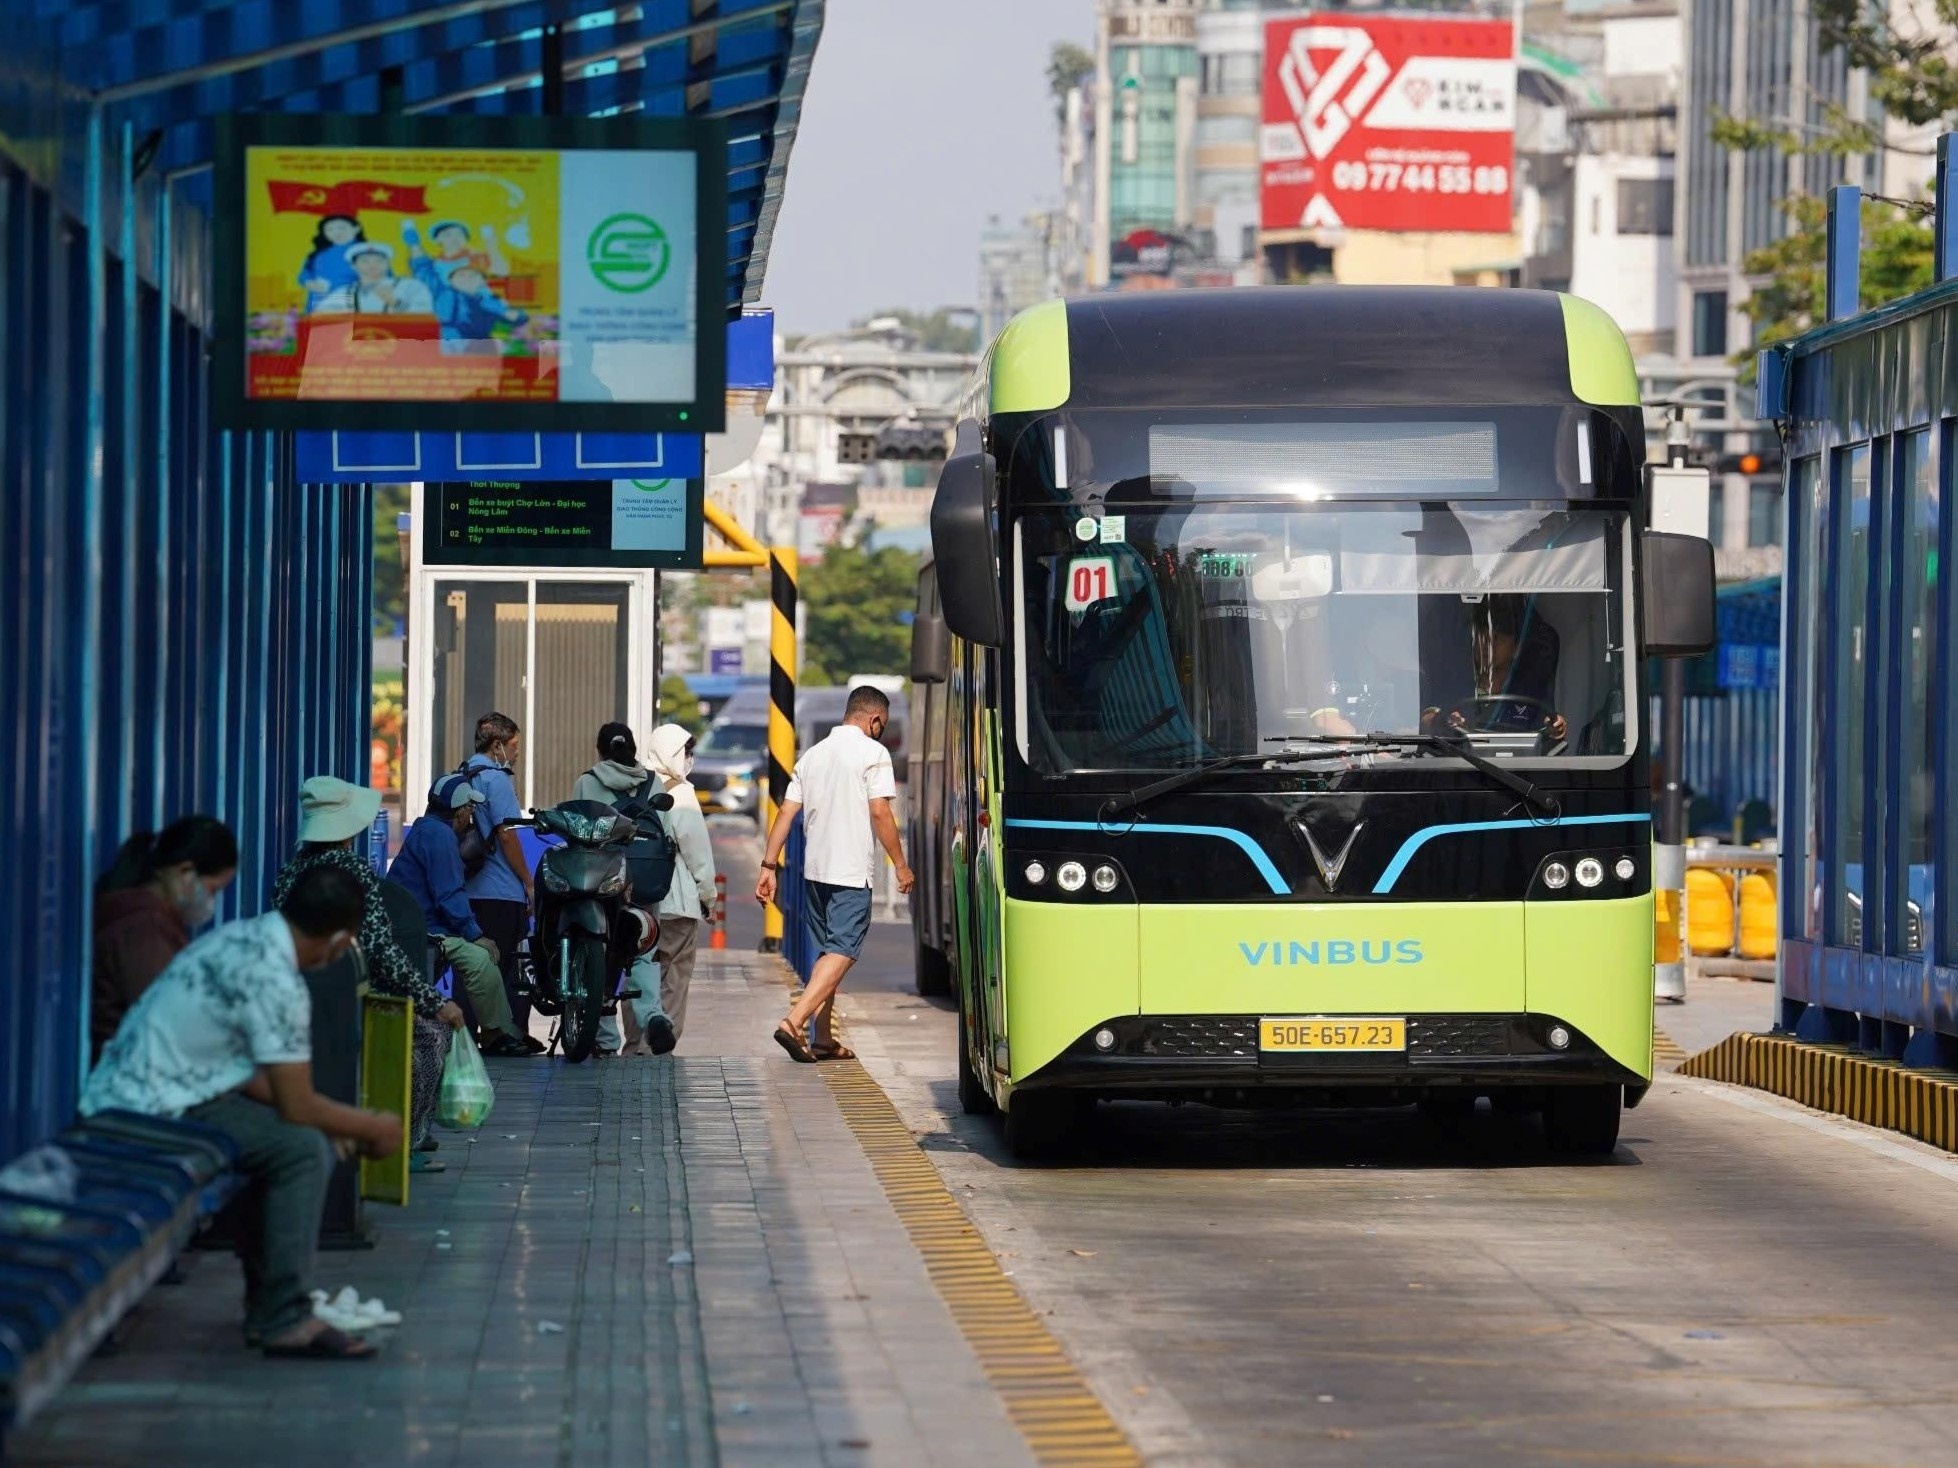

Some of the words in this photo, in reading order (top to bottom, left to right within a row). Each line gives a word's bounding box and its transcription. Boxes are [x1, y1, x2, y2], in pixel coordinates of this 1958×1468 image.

[1369, 163, 1402, 191] 77
[1073, 566, 1106, 602] 01
[1238, 940, 1424, 966] VINBUS
[1272, 1026, 1393, 1045] 50E-657.23
